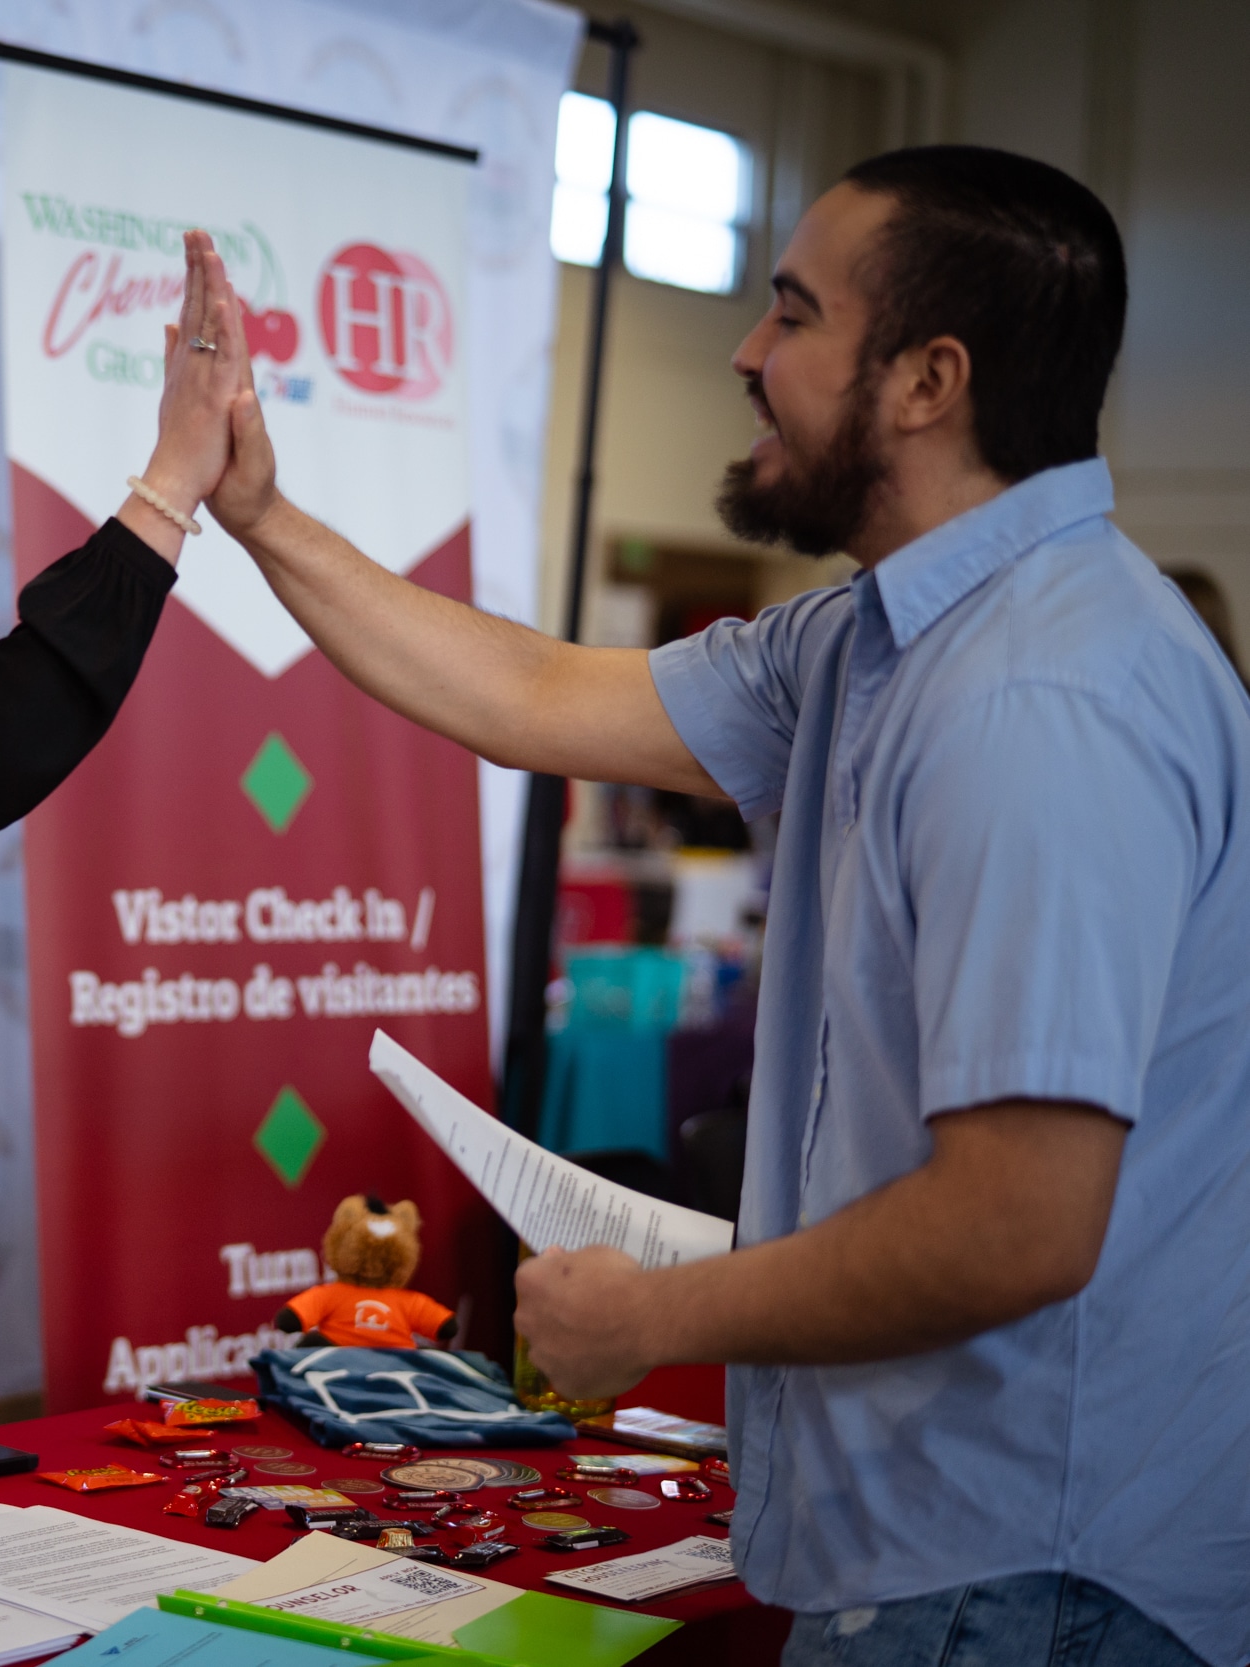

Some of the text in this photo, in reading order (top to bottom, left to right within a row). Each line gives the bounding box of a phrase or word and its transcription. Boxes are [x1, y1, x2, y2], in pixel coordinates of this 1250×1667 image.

[21, 190, 250, 266] WASHINGN
[42, 249, 187, 359] Cherr
[326, 264, 453, 386] HR
[247, 886, 362, 942] Check
[69, 962, 480, 1038] Registro de visitantes
[219, 1242, 320, 1299] Turn
[265, 1584, 361, 1611] OUNSELOR
